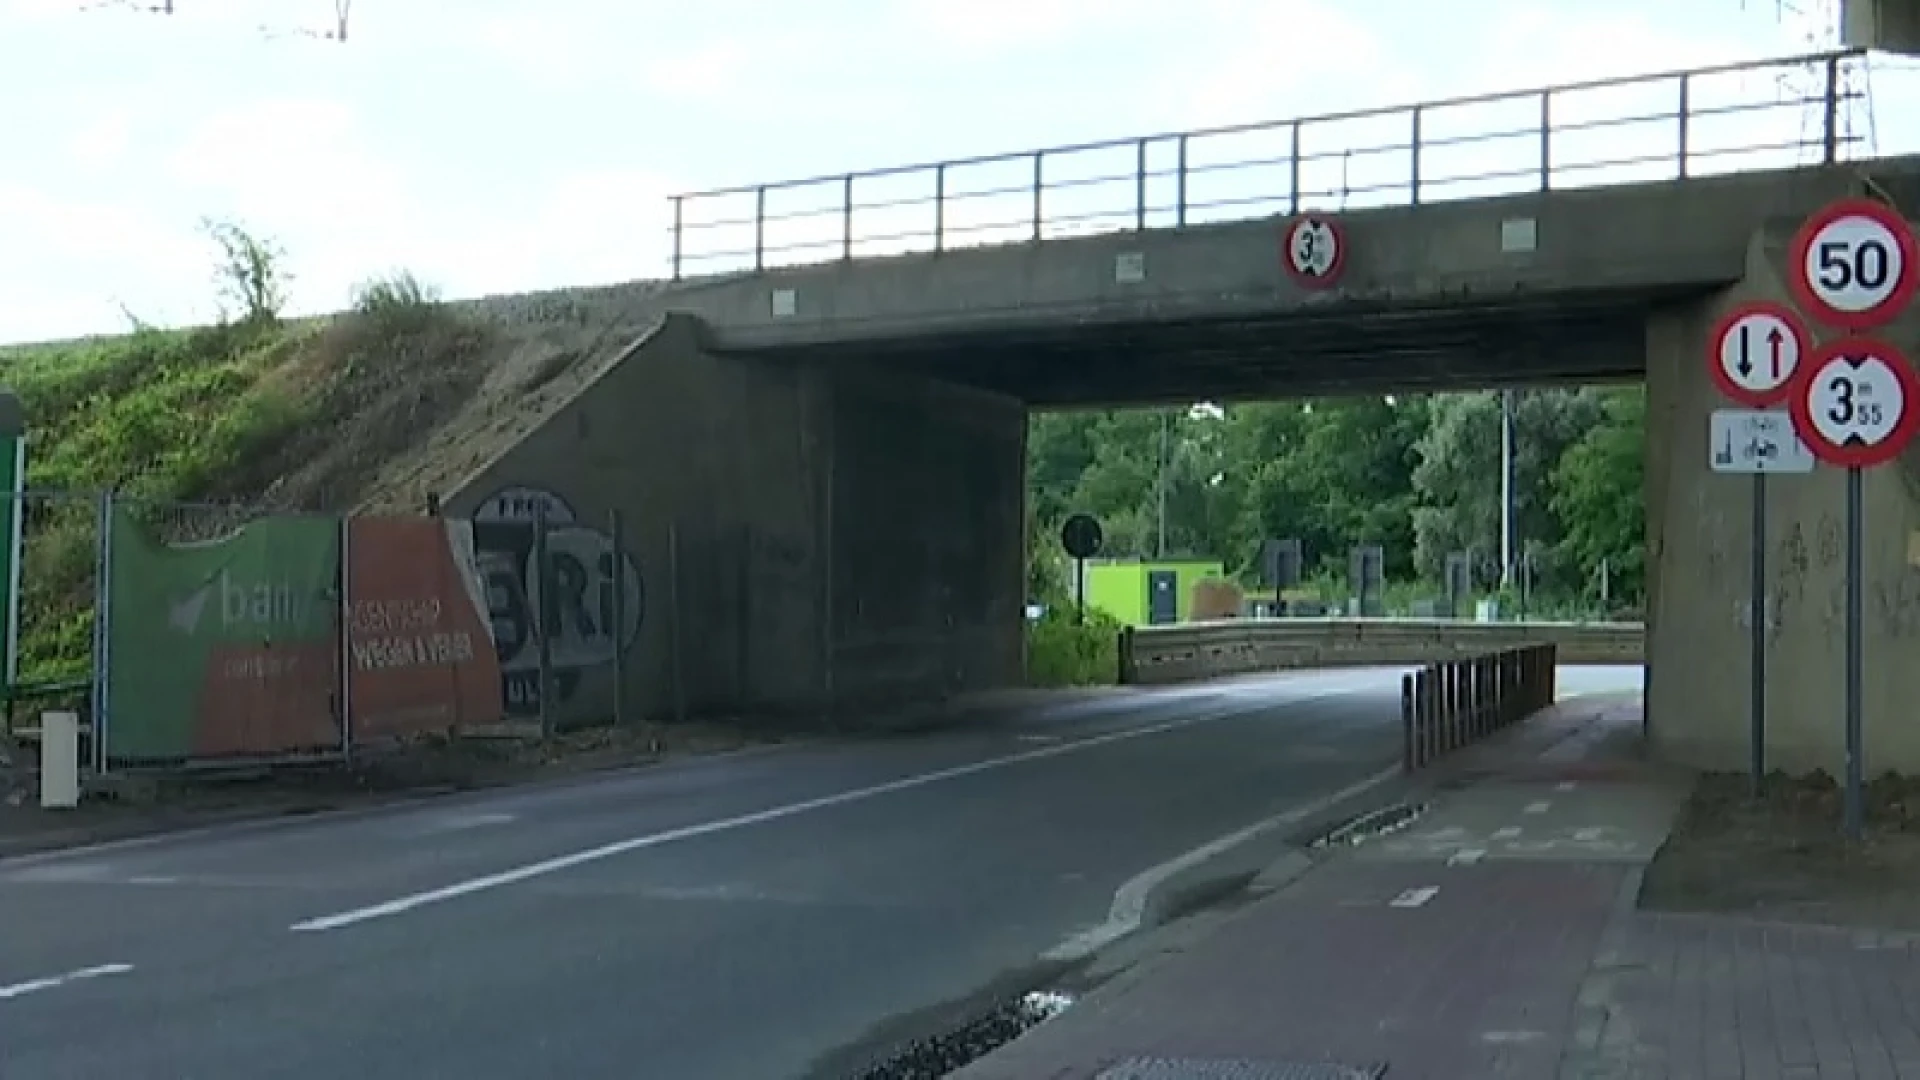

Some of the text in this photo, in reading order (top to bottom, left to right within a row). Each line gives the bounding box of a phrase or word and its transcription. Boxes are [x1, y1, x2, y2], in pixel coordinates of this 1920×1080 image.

[1300, 230, 1314, 262] 3
[1819, 239, 1888, 291] 50
[1828, 376, 1854, 425] 3
[1857, 404, 1882, 426] 55
